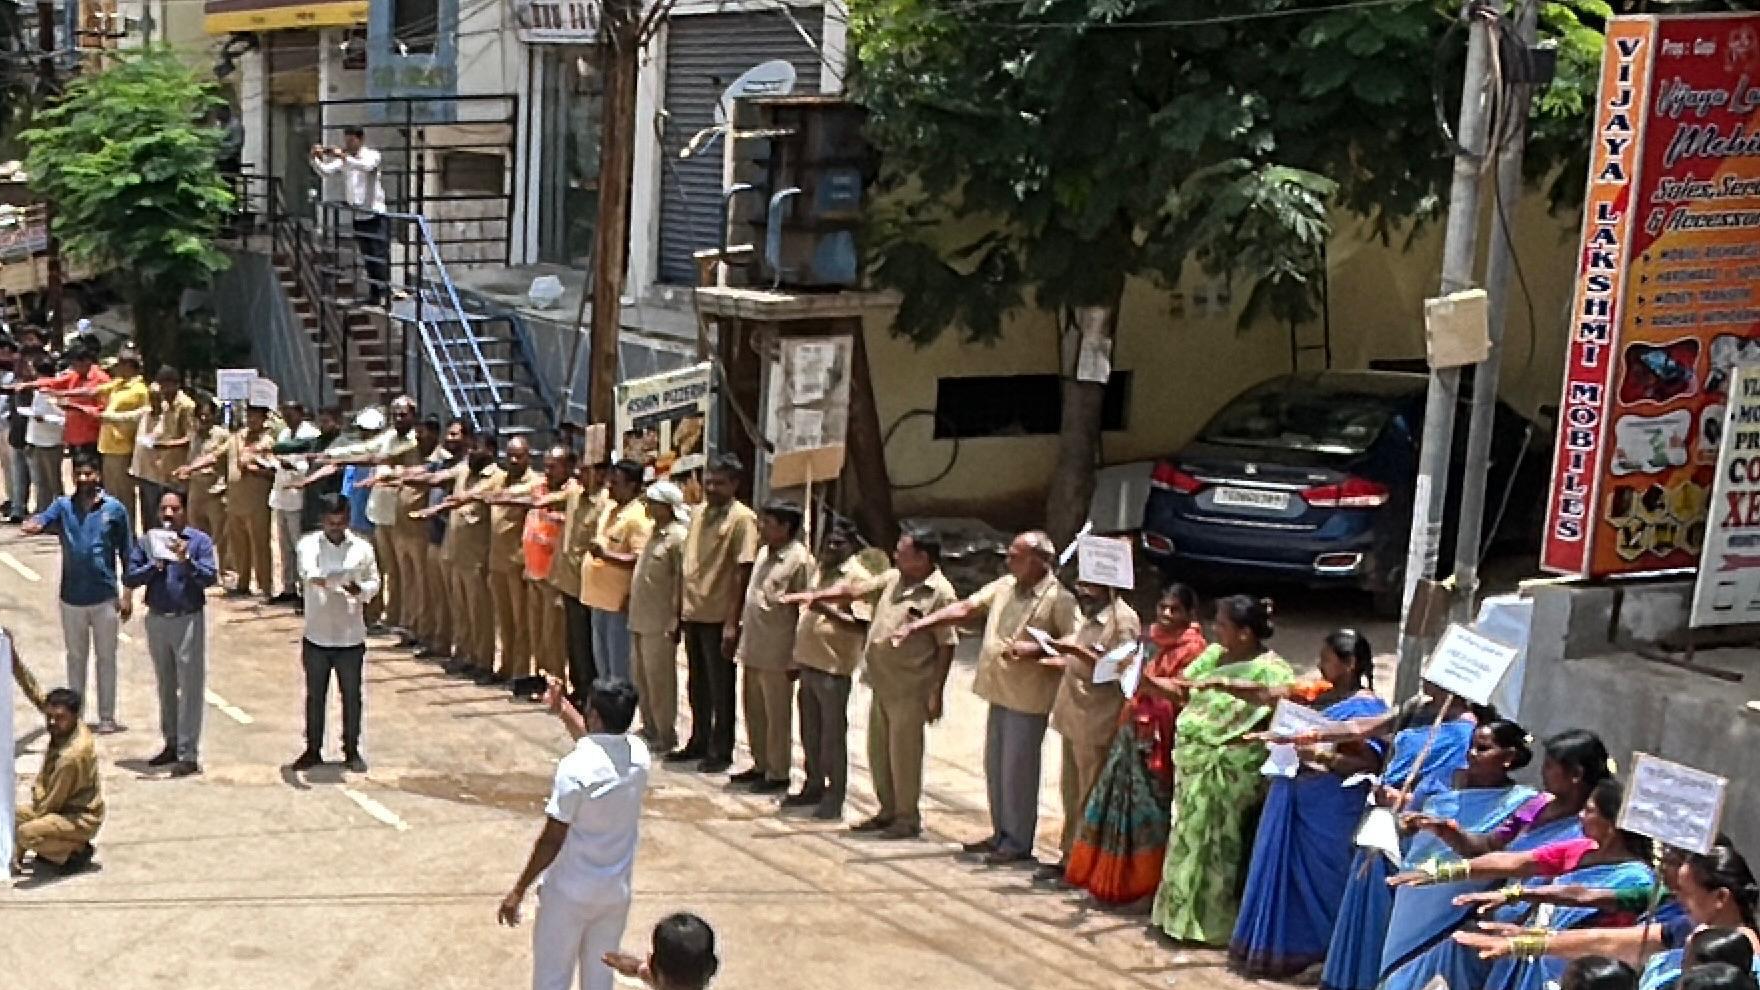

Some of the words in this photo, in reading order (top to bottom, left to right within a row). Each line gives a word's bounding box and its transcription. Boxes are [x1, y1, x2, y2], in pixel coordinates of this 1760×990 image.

[1598, 39, 1644, 184] VIJAYA
[1656, 76, 1729, 119] Vijaya
[1579, 203, 1620, 367] LAKSHMI
[1555, 382, 1603, 540] MOBILES
